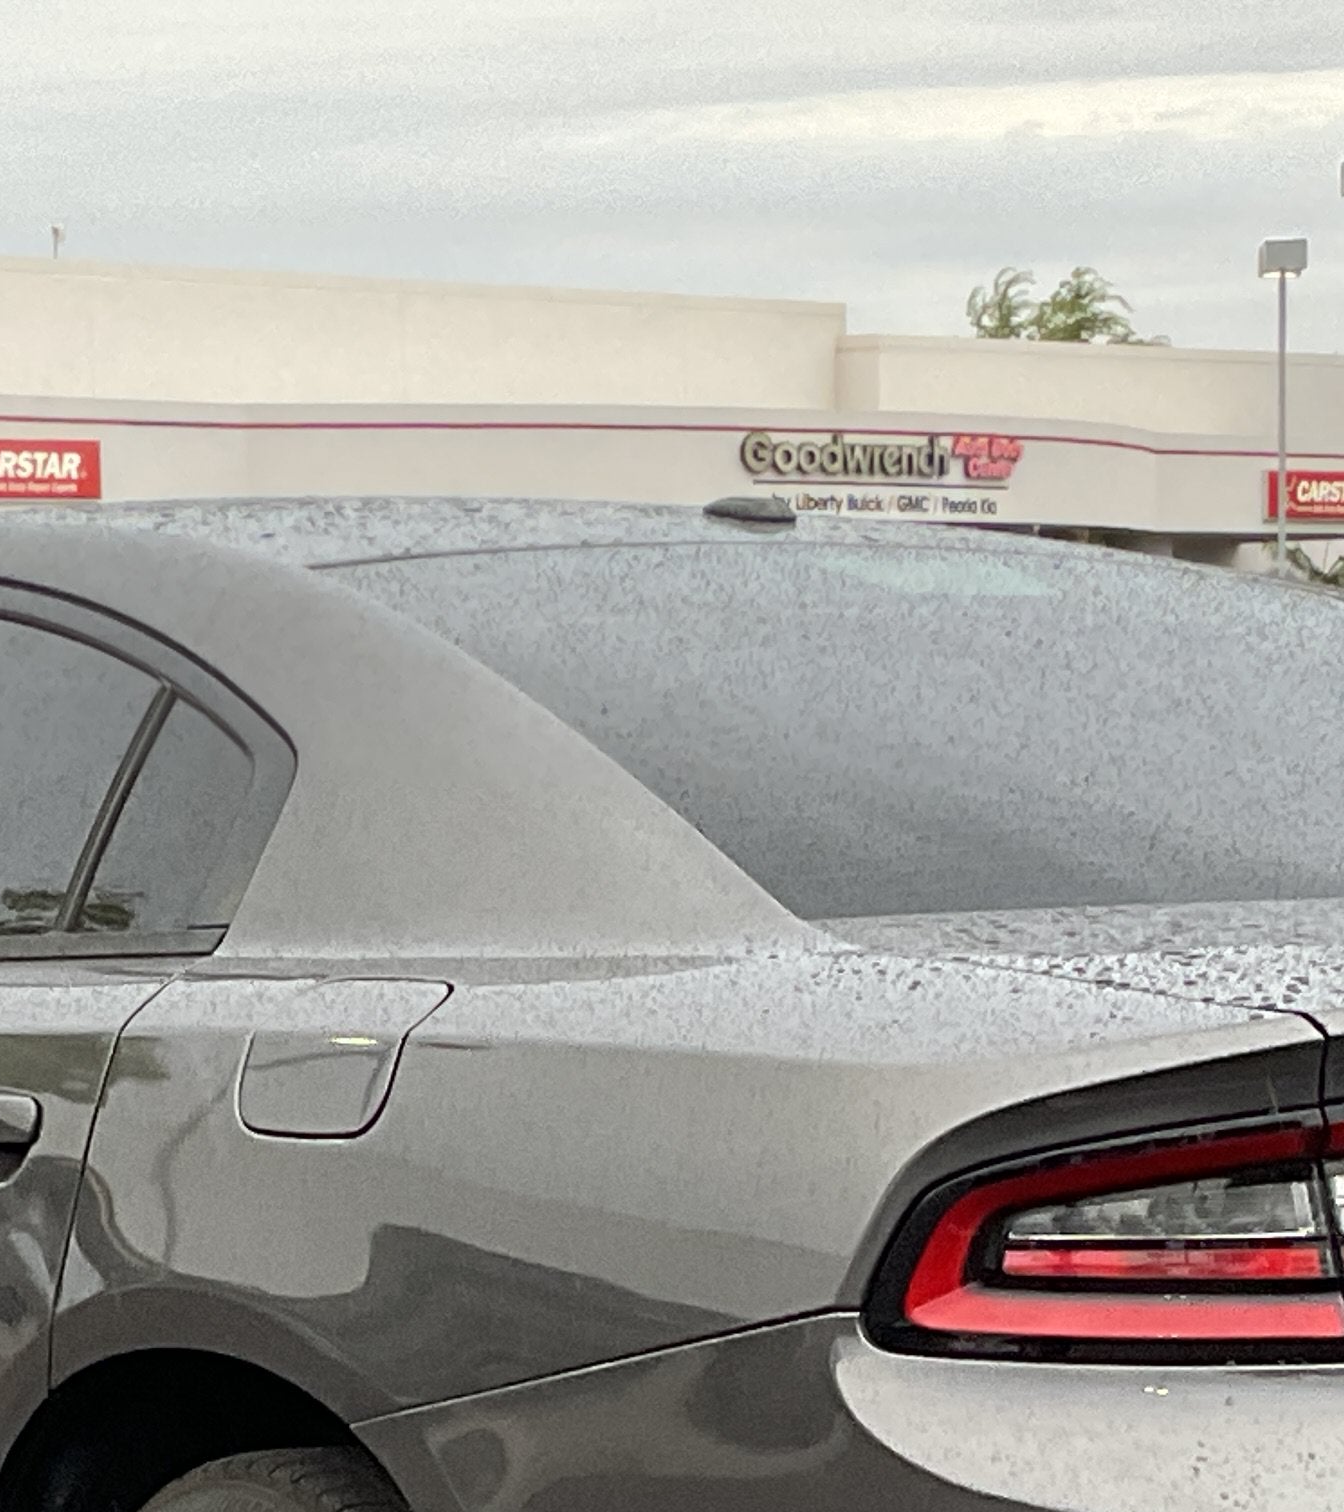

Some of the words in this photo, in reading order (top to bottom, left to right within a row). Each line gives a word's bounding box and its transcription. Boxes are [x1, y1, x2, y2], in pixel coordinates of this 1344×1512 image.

[740, 431, 950, 478] Goodwrench
[796, 493, 843, 515] Liberty
[847, 493, 883, 512] Buick
[897, 495, 930, 513] GMC
